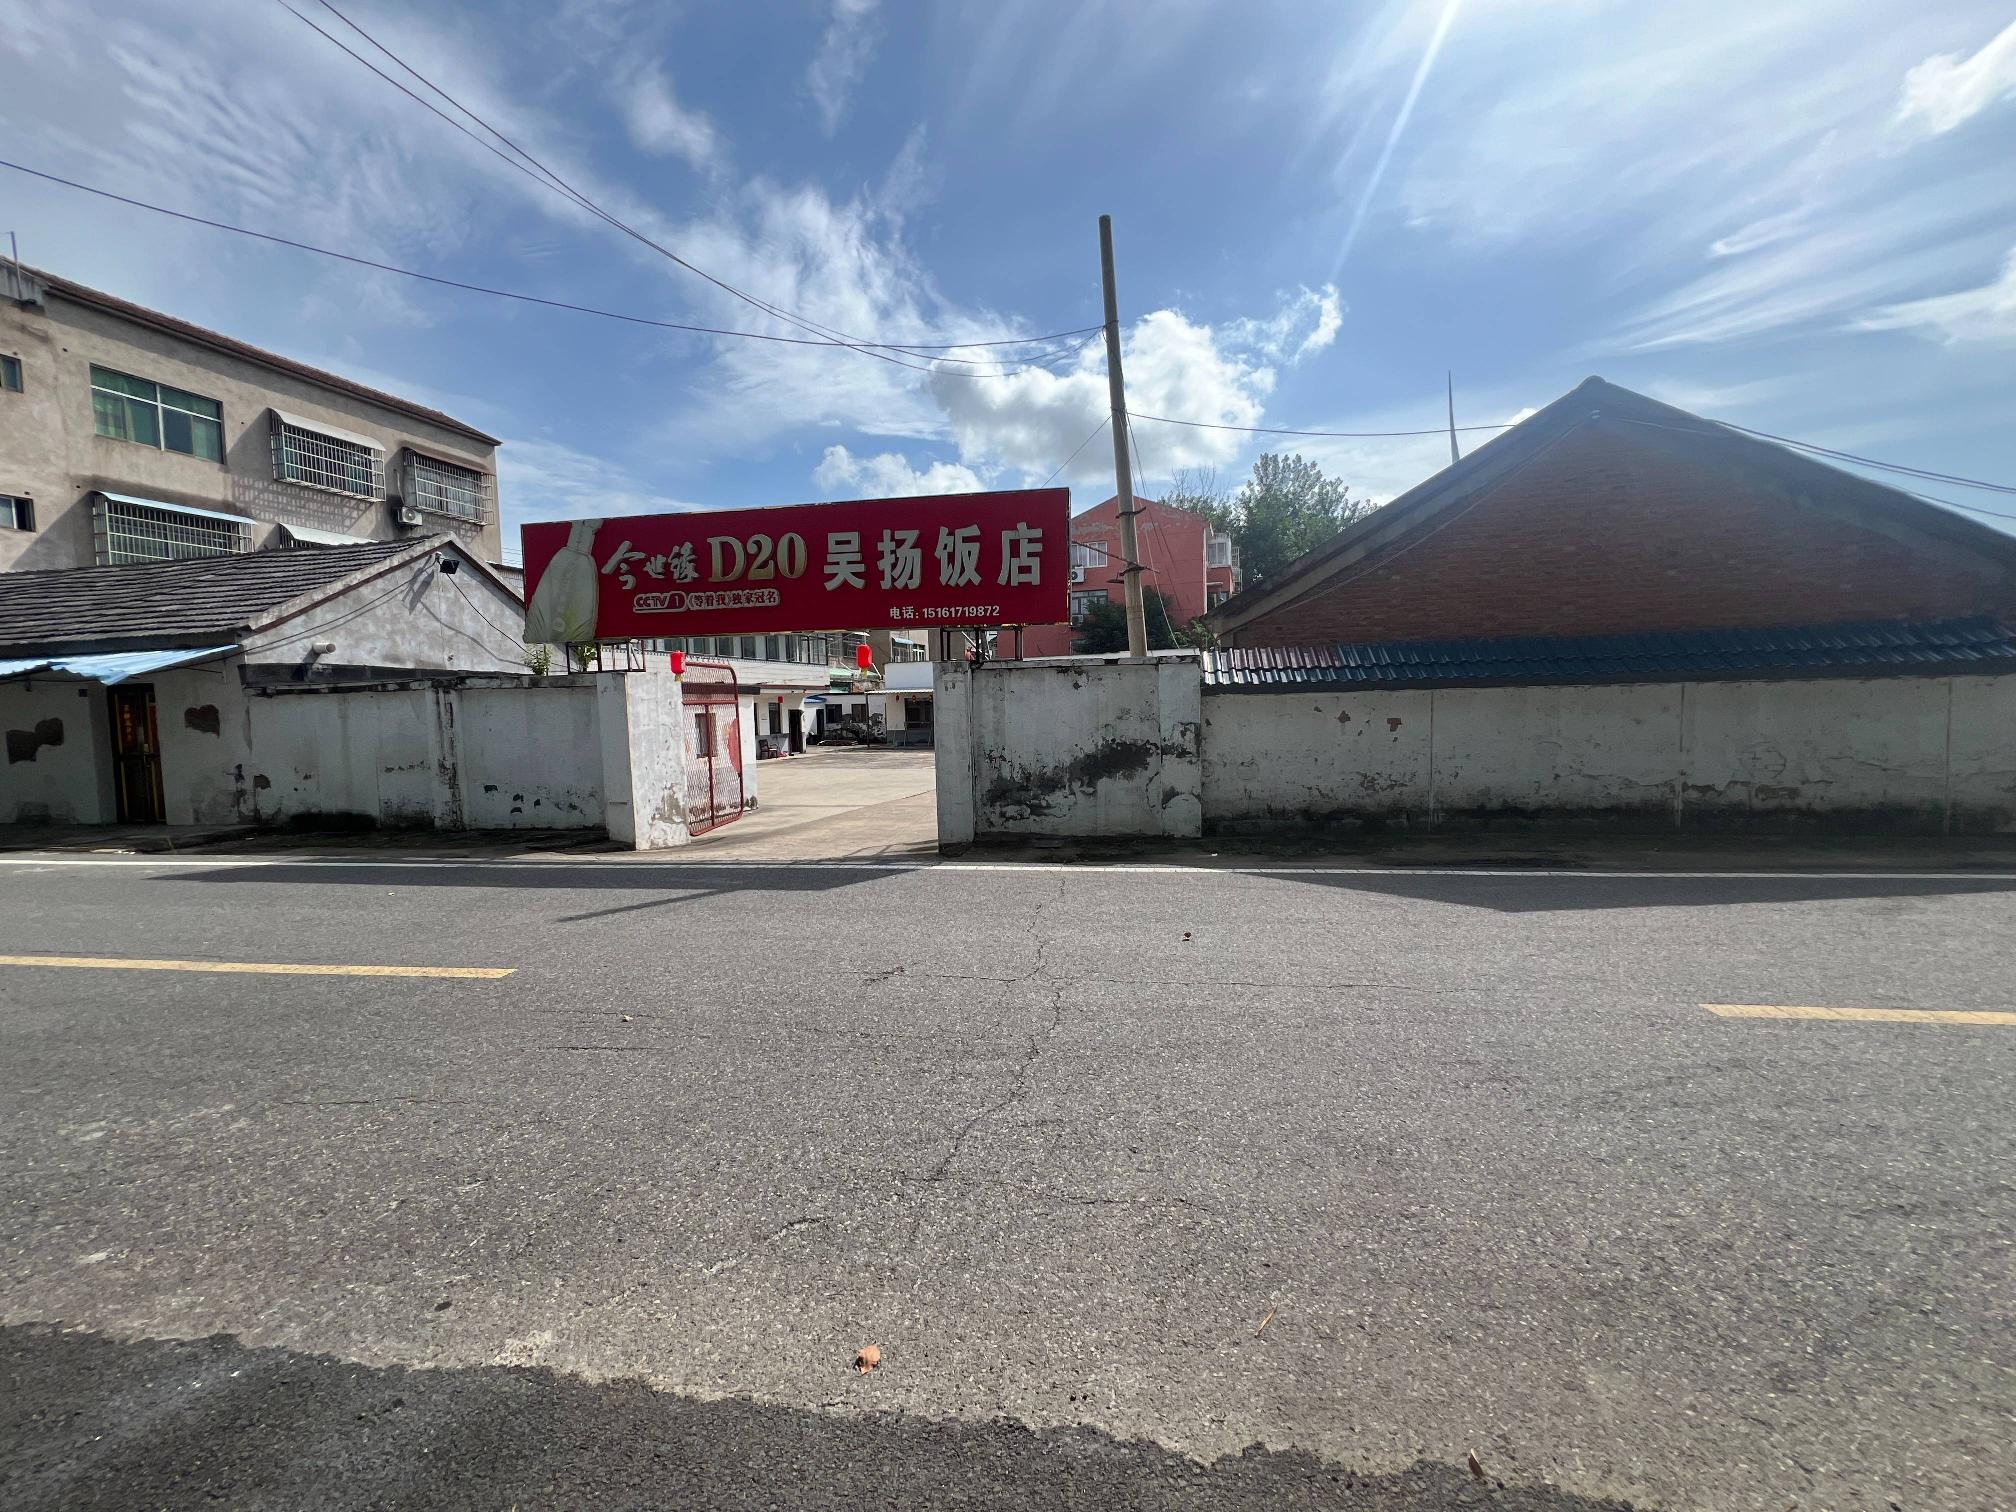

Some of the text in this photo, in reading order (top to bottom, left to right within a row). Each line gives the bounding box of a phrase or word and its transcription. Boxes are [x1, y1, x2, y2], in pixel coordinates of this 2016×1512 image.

[707, 532, 808, 583] D20
[824, 522, 1043, 591] 吴扬饭店
